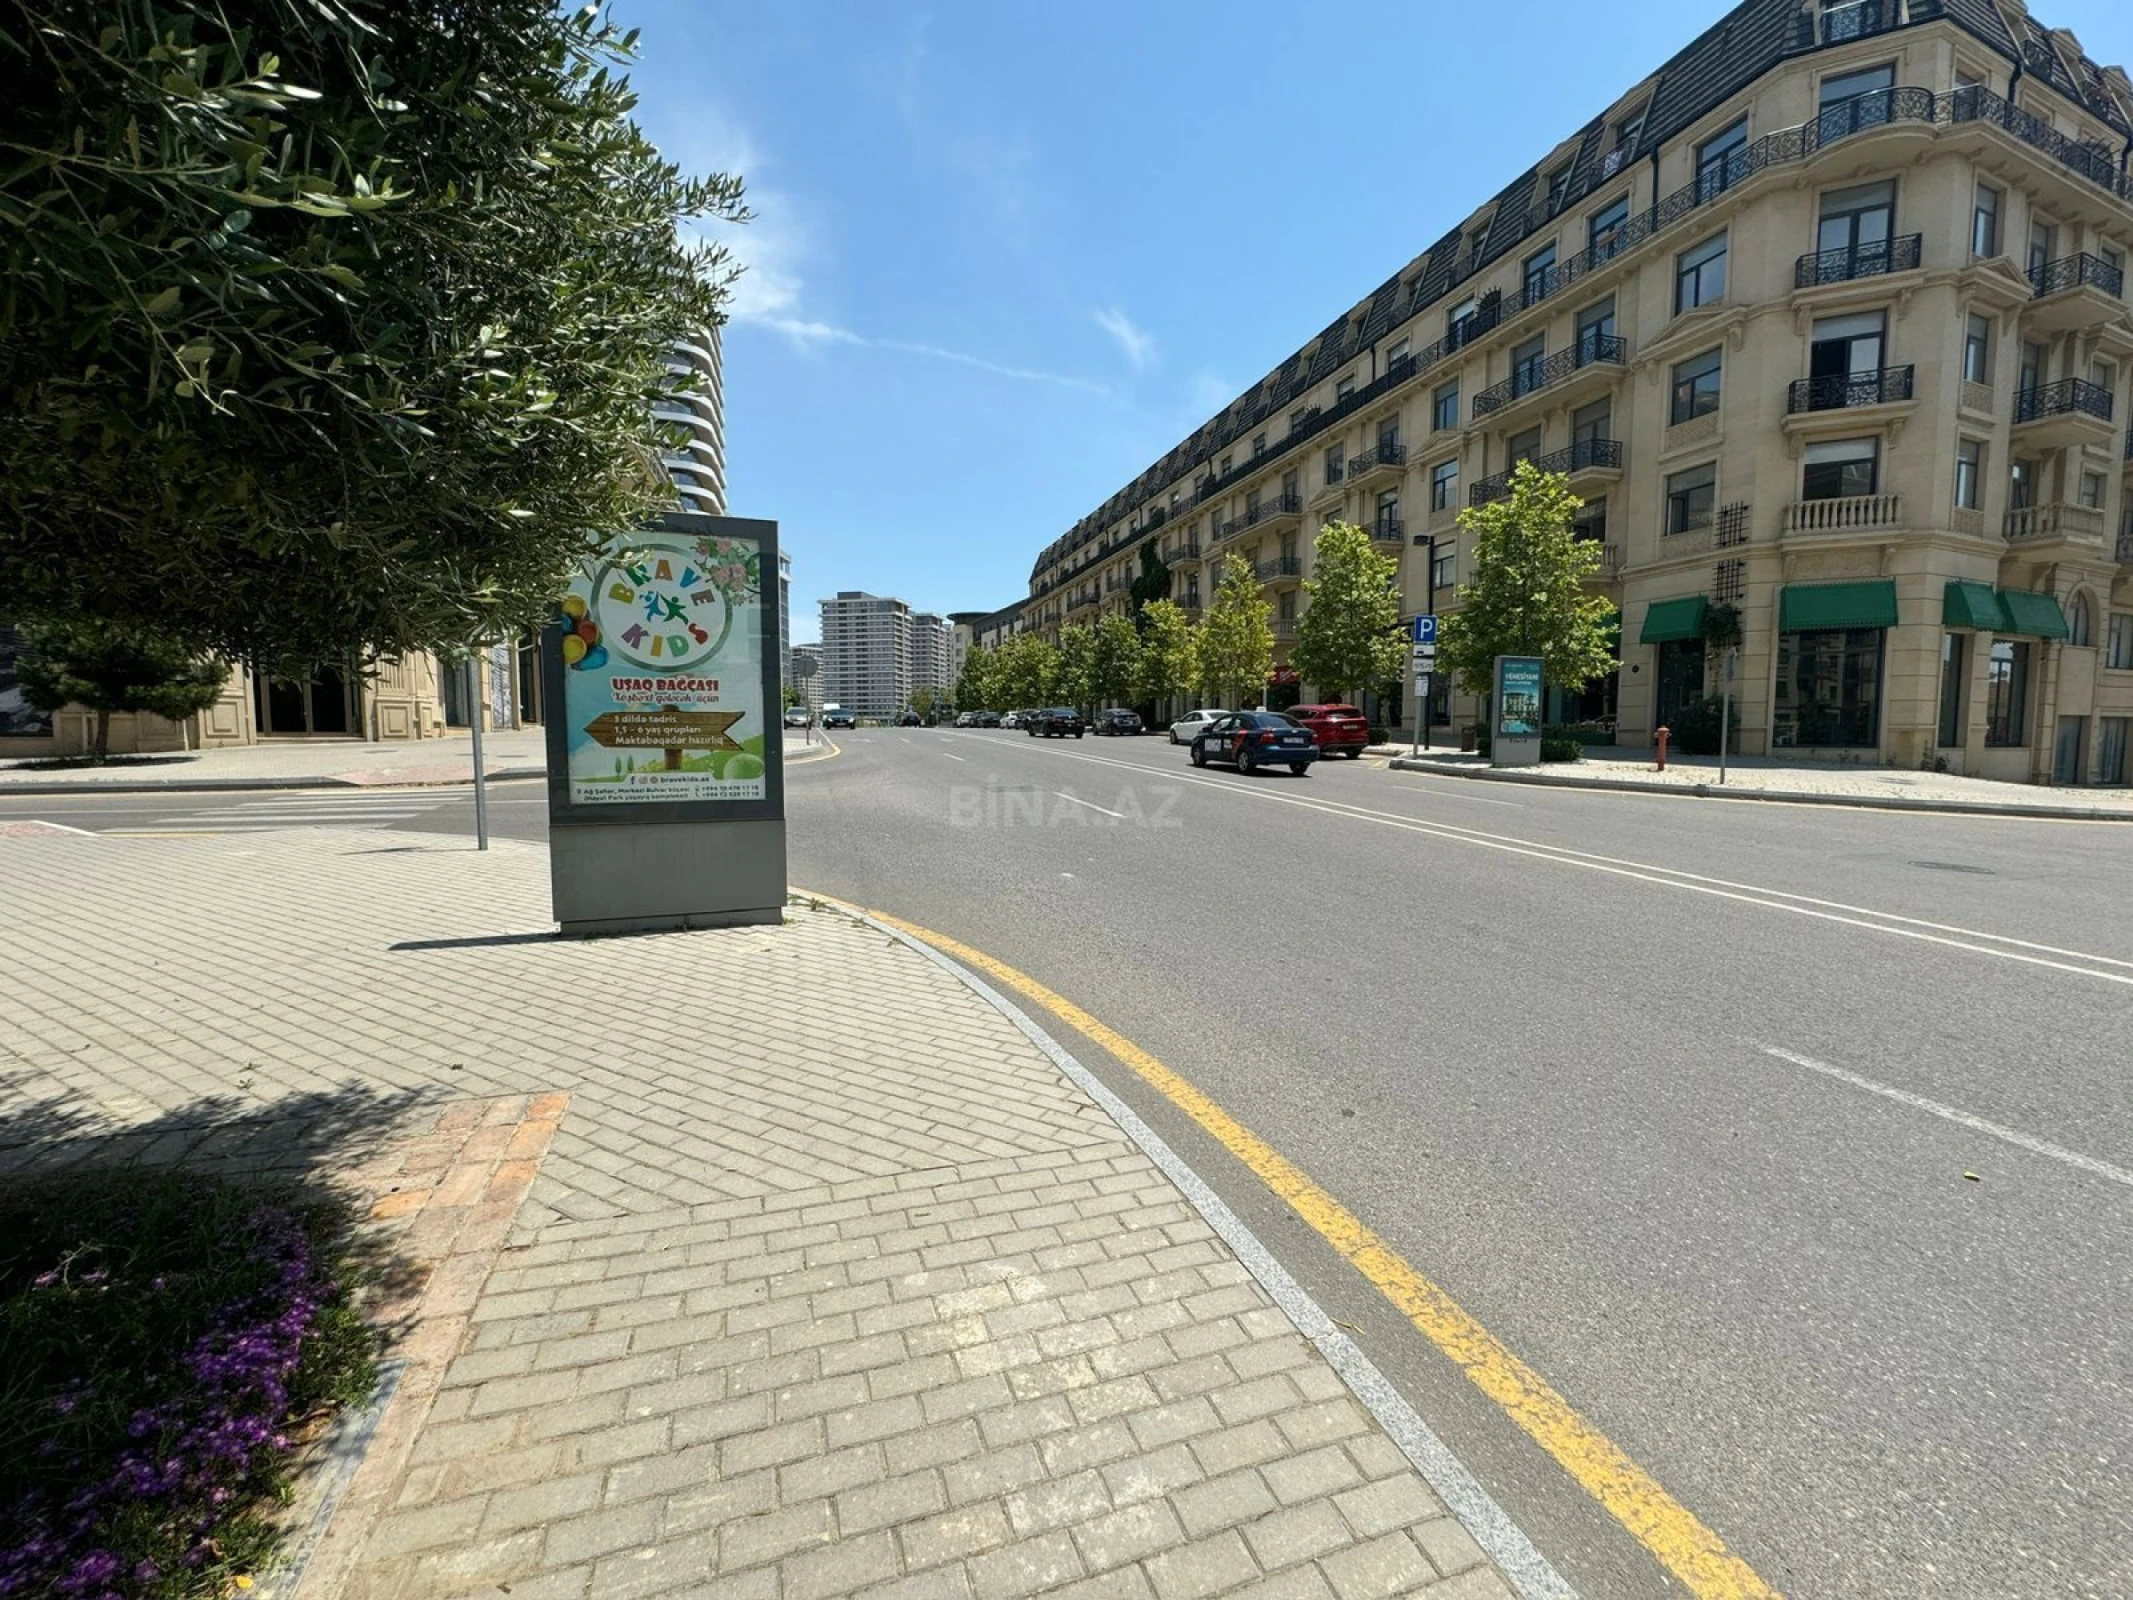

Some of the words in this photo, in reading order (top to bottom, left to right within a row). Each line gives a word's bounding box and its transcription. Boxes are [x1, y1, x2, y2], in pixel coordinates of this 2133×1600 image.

[608, 559, 716, 606] BRAVE
[621, 623, 708, 658] KIDS
[1420, 618, 1433, 640] P
[612, 678, 654, 692] UŞAQ
[656, 676, 719, 692] BAĞÇASI
